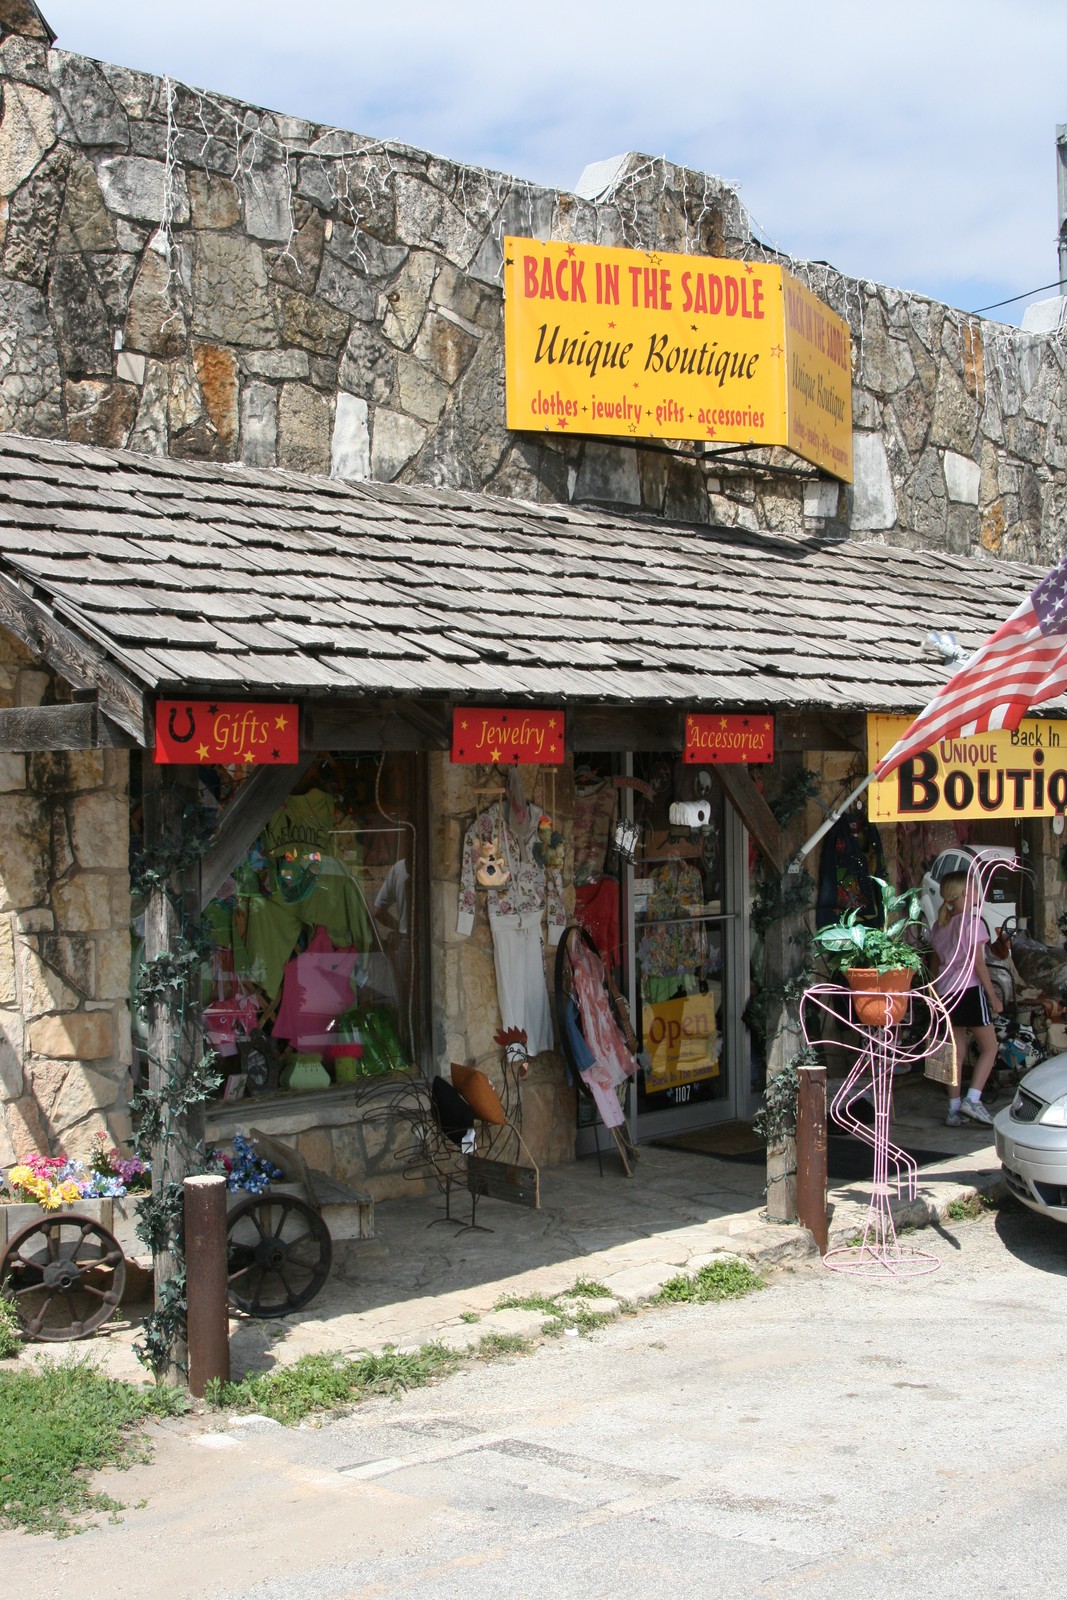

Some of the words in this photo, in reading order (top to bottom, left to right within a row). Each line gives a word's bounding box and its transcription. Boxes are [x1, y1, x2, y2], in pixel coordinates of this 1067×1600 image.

[523, 255, 587, 304] BACK
[595, 262, 620, 306] IN
[628, 266, 672, 312] THE
[681, 271, 765, 320] SADDLE
[534, 323, 633, 378] Unique
[644, 333, 759, 388] Boutique
[792, 352, 816, 406] Unique
[816, 373, 845, 427] Boutique
[531, 390, 578, 417] clothes
[591, 395, 642, 424] jewelry
[655, 399, 685, 426] gifts
[697, 404, 765, 428] accessories
[213, 709, 269, 756] Gifts
[475, 718, 545, 754] Jewelry
[687, 725, 765, 750] Accessories
[1010, 724, 1043, 747] Back
[1048, 725, 1060, 747] In
[939, 737, 998, 766] UNIQUE
[649, 1013, 709, 1049] Open
[675, 1085, 691, 1103] 1107
